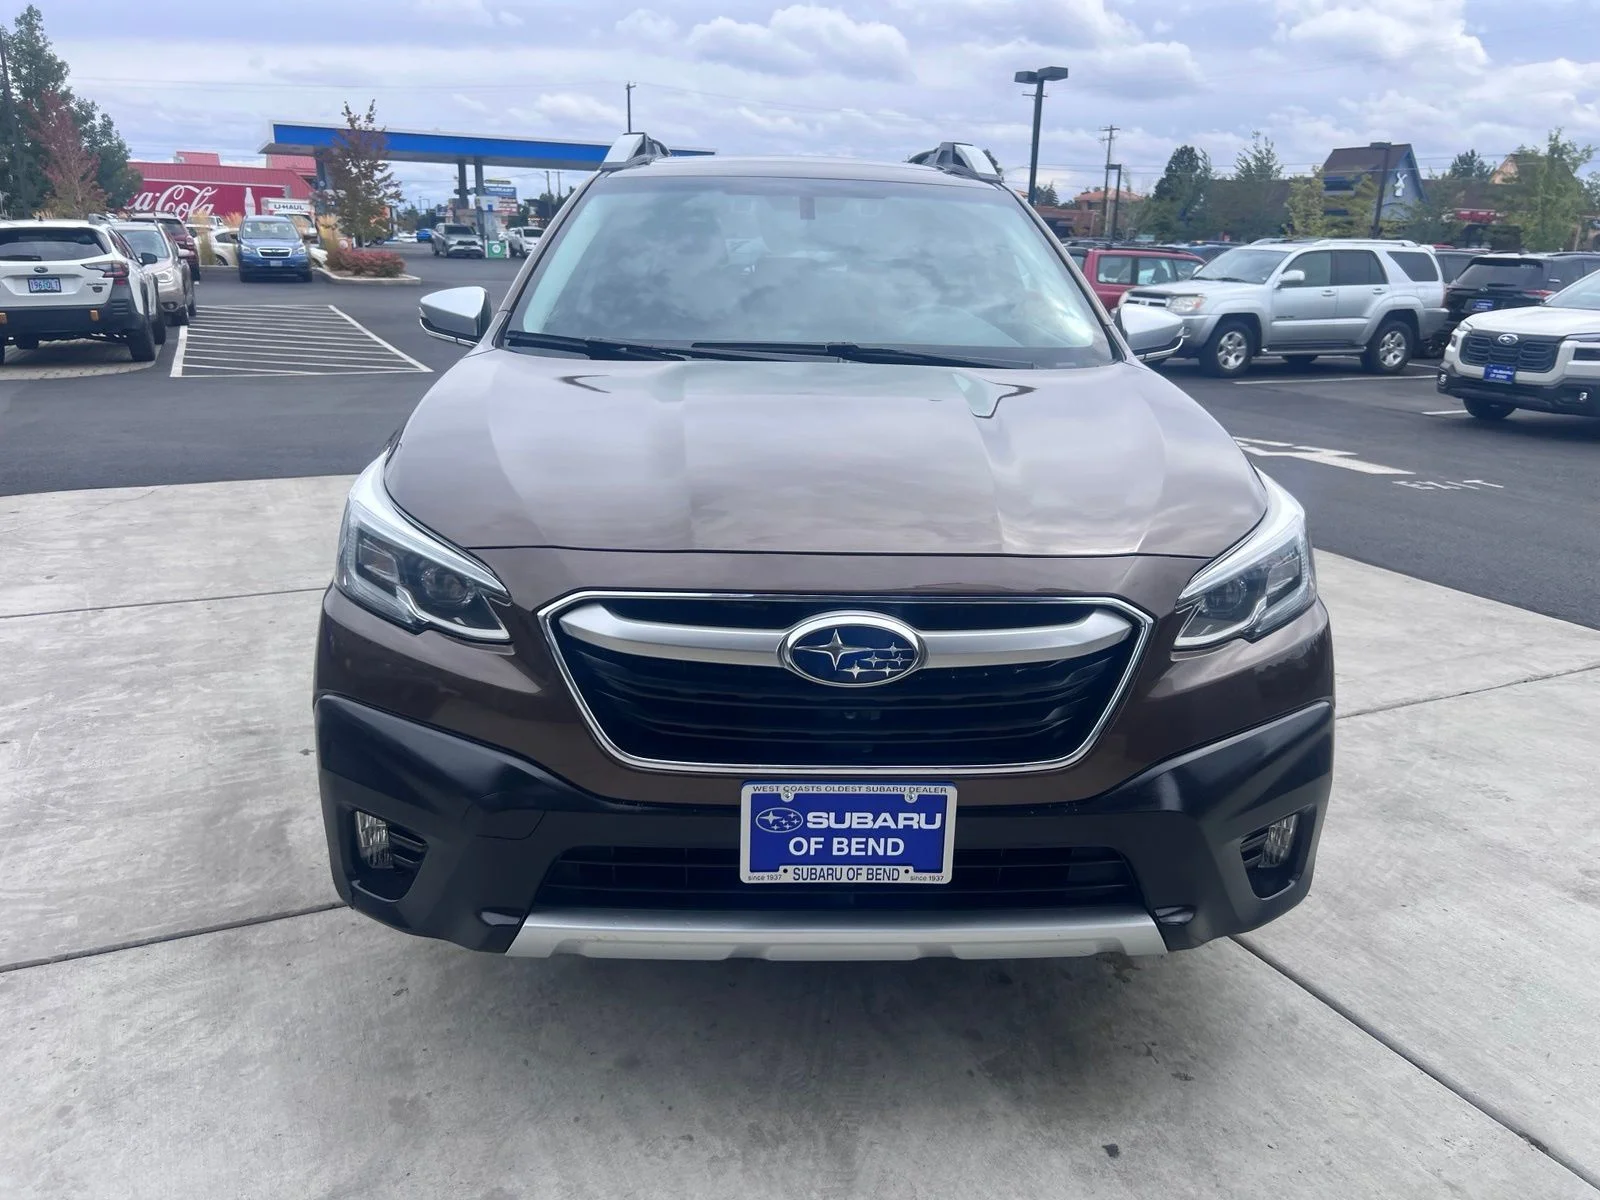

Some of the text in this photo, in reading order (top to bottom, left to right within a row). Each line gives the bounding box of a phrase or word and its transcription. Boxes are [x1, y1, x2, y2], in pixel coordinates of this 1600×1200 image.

[123, 184, 218, 220] a-Cola
[752, 785, 780, 793] WEST
[783, 785, 822, 793] COASTS
[908, 786, 948, 794] DEALER
[806, 811, 942, 830] SUBARU
[788, 836, 905, 856] OF BEND
[792, 867, 900, 881] SUBARU OF BEND
